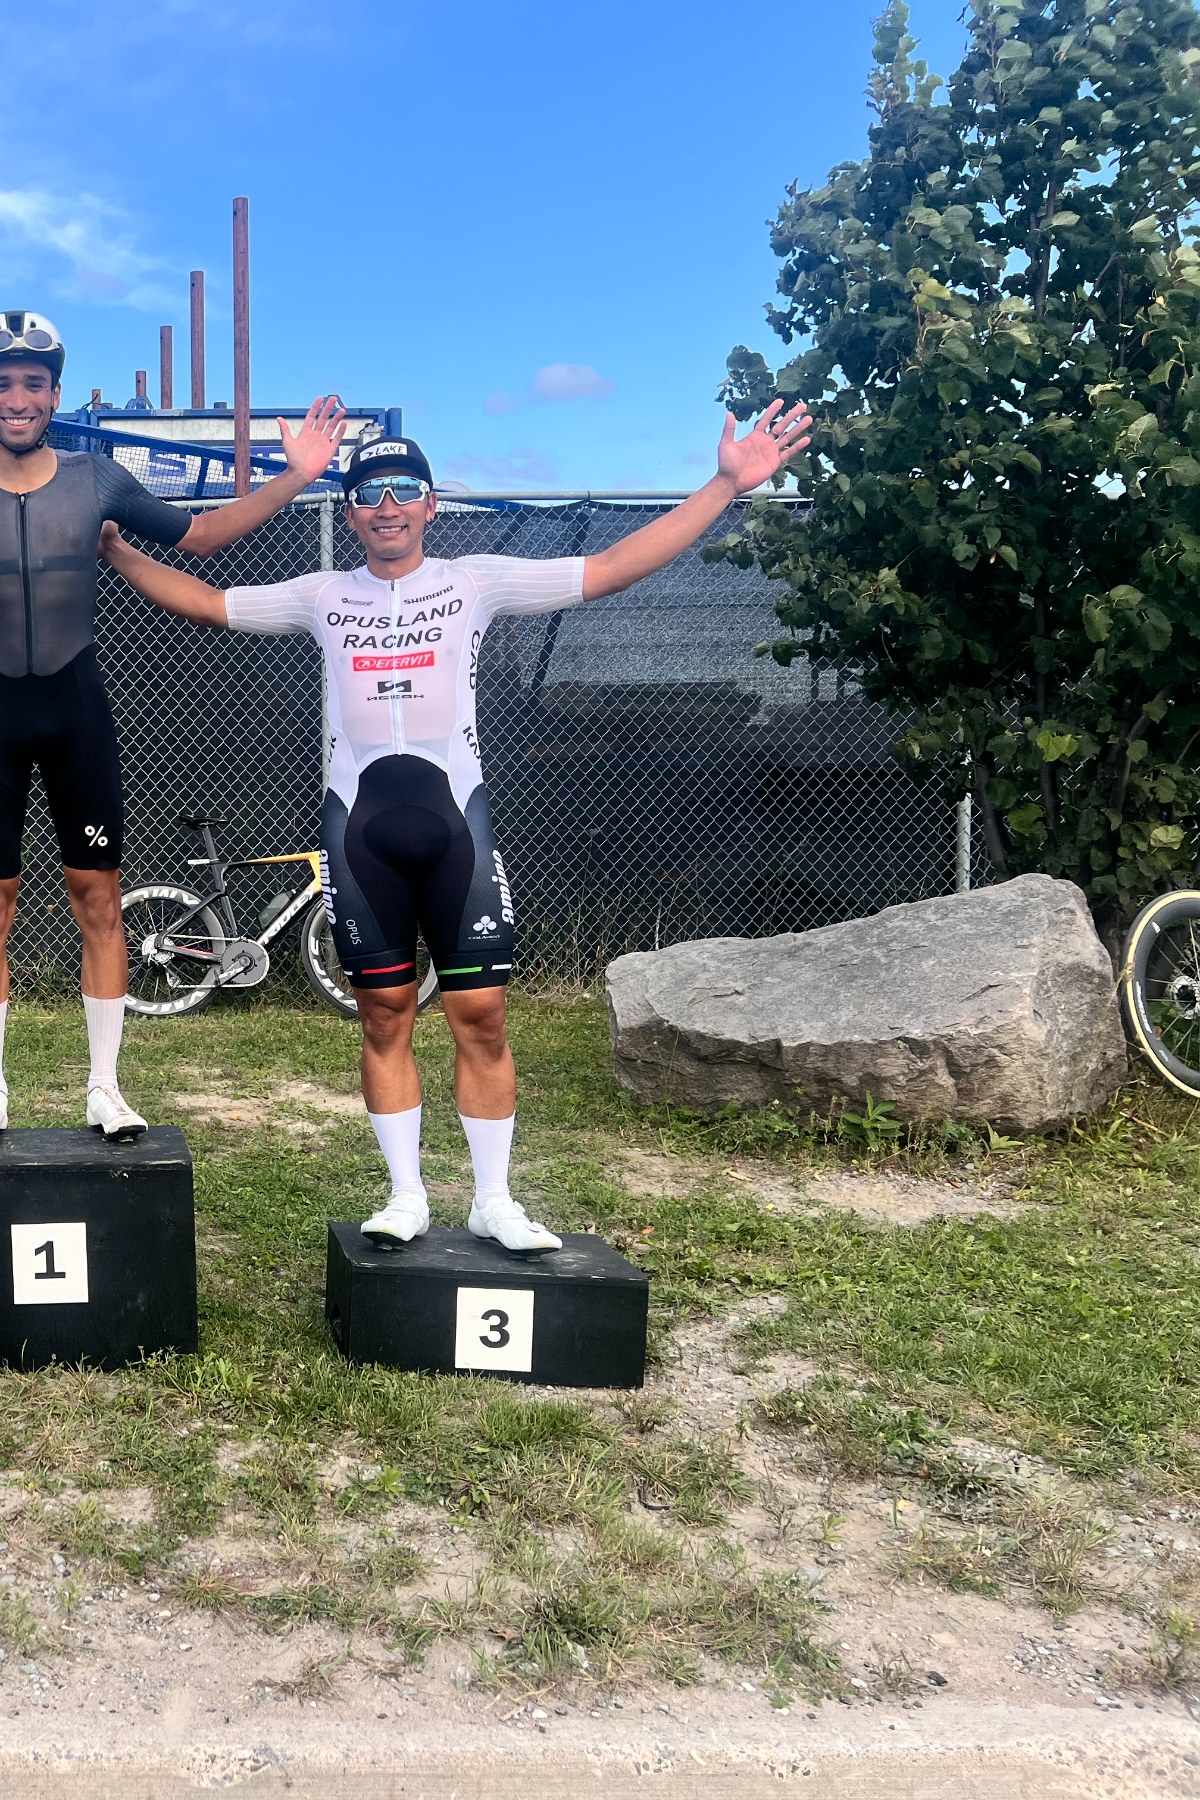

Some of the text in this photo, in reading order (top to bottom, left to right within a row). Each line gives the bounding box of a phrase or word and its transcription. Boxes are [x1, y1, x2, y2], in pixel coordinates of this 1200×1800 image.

[375, 444, 405, 456] LAKE
[403, 585, 454, 605] SHIMANO
[326, 611, 390, 629] OPUS
[396, 598, 463, 627] LAND
[342, 627, 442, 649] RACING
[376, 653, 432, 669] ENERVIT
[319, 848, 338, 925] amino
[491, 849, 515, 925] amino
[262, 888, 314, 944] RIDLEY
[345, 919, 362, 945] OPUS
[33, 1240, 67, 1280] 1
[480, 1310, 511, 1349] 3
